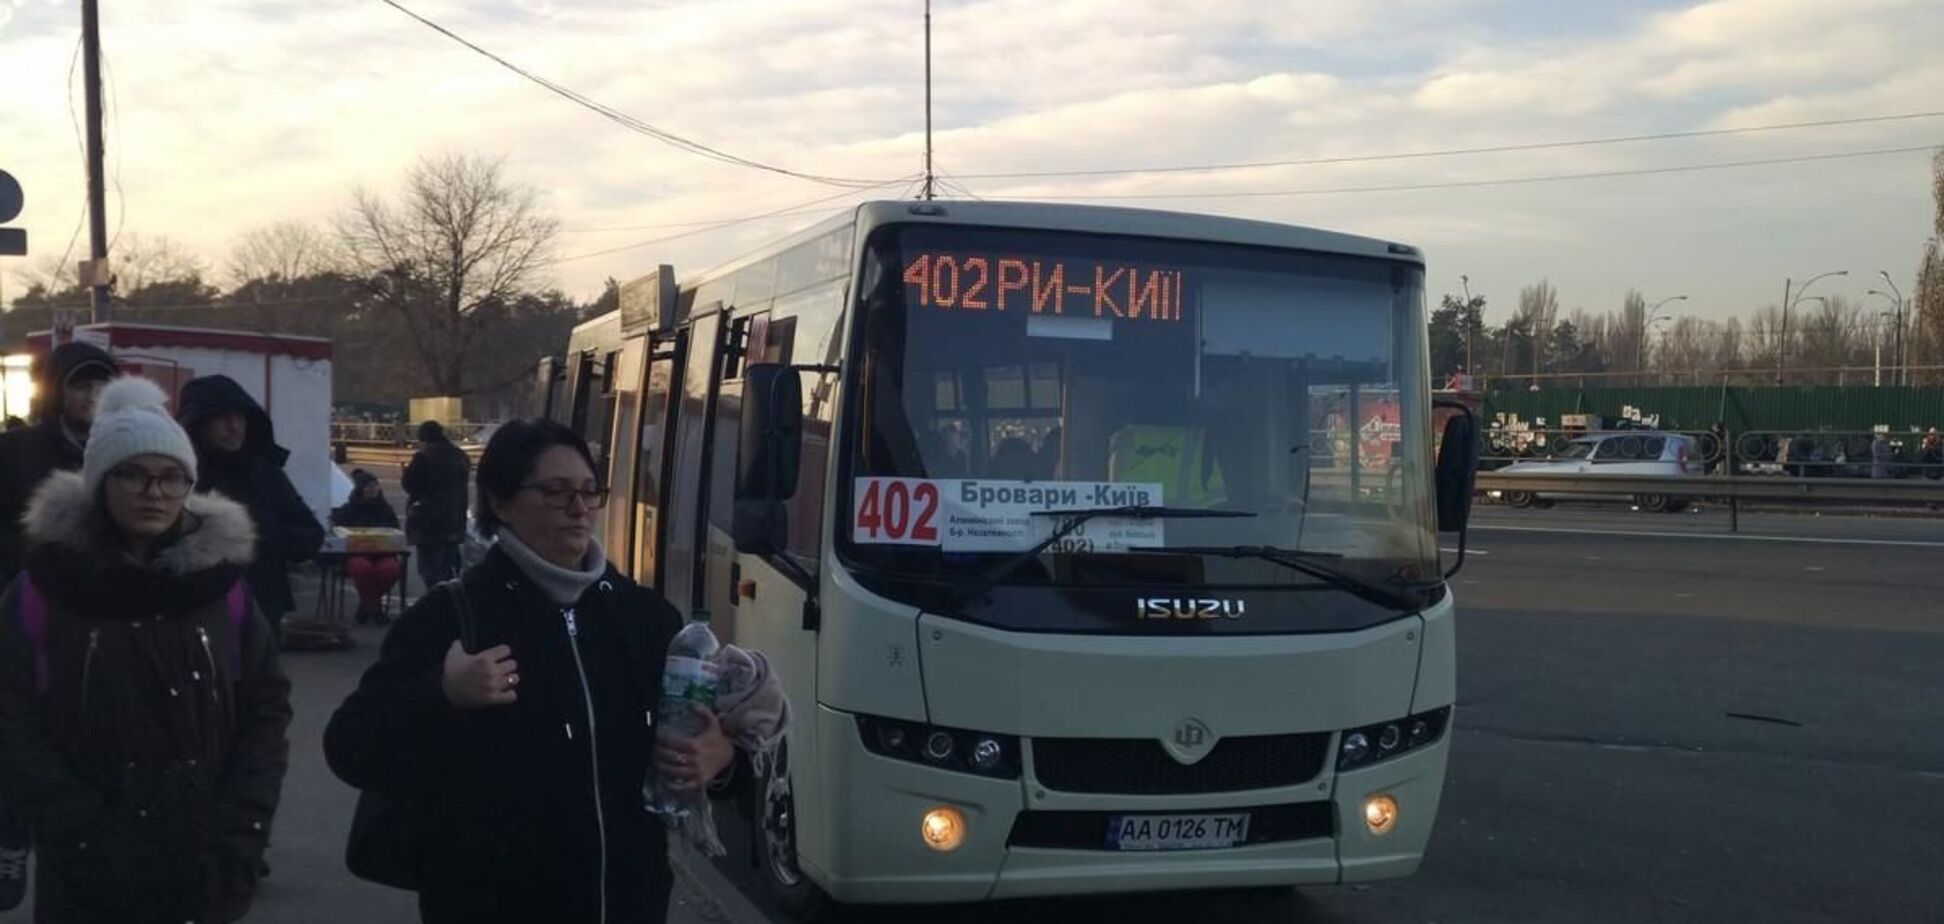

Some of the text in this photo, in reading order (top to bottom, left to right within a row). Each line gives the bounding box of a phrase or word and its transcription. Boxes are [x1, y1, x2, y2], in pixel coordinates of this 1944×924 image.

[903, 254, 988, 309] 402
[961, 481, 1077, 508] Бровари
[857, 480, 939, 540] 402
[1046, 538, 1094, 553] 402)
[1137, 598, 1245, 619] ISUZU
[1121, 818, 1243, 840] AA 0126 TM
